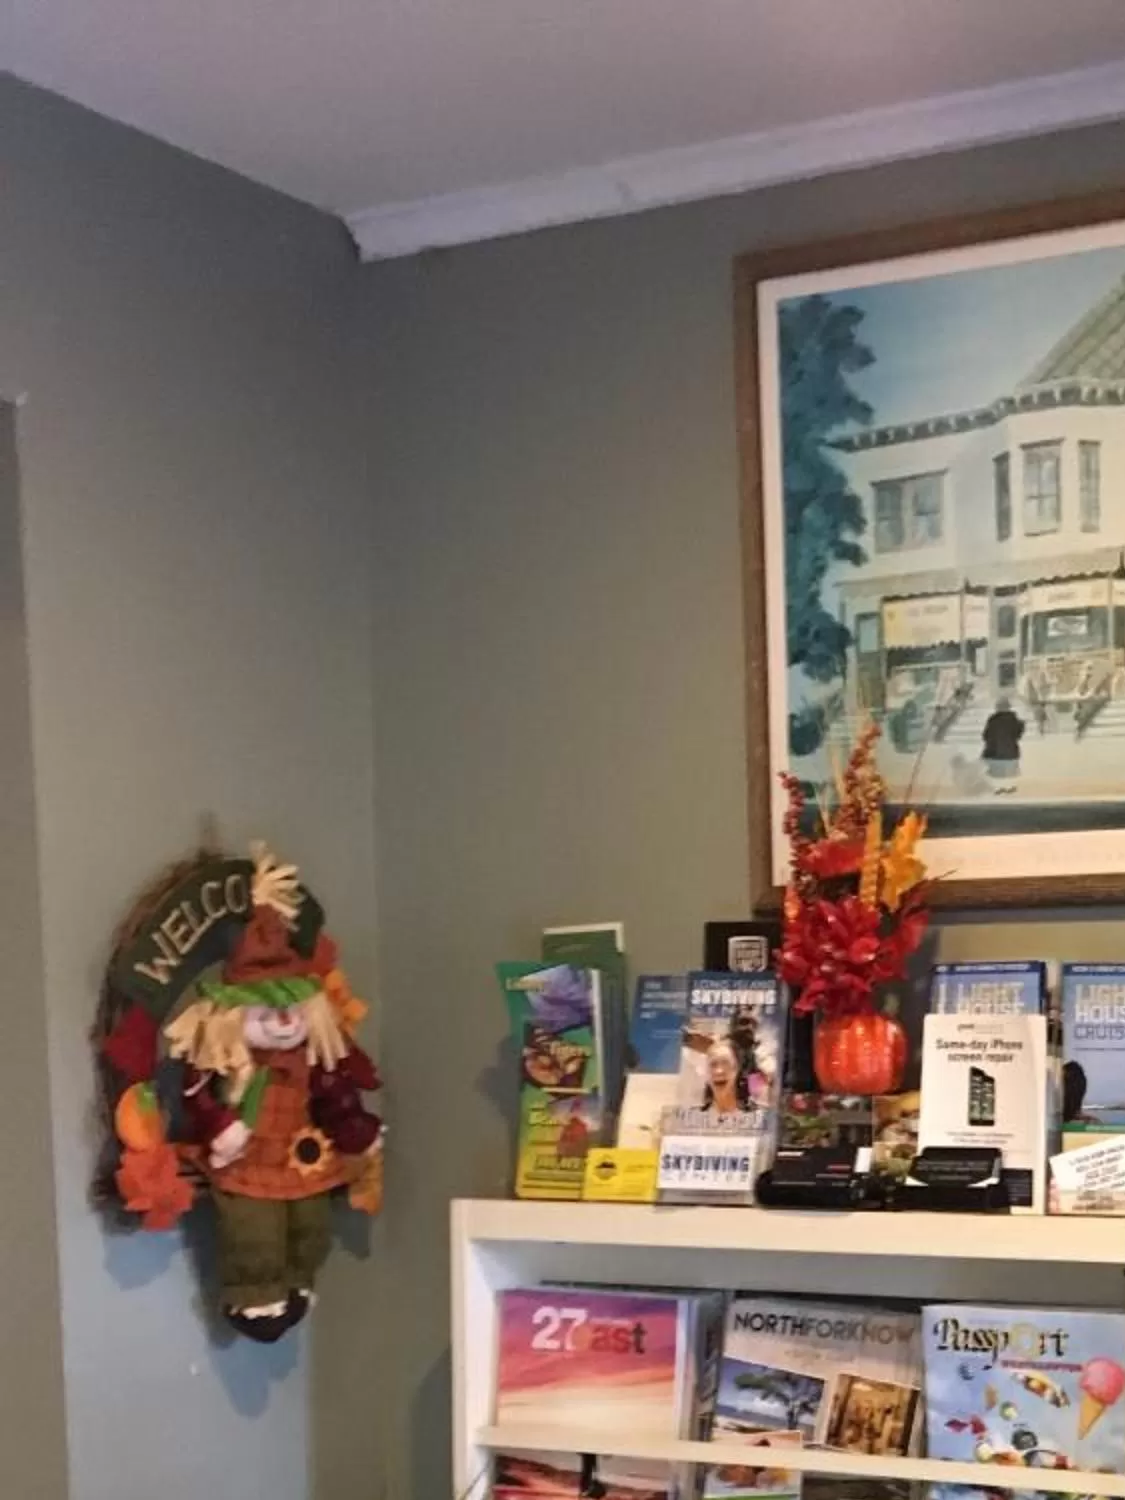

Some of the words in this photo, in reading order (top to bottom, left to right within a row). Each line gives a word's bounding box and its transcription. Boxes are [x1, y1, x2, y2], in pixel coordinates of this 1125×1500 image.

[134, 872, 248, 985] WELCO
[936, 1037, 989, 1053] Same-day
[990, 1038, 1024, 1051] iPhone
[661, 1153, 751, 1172] SKYDIVING
